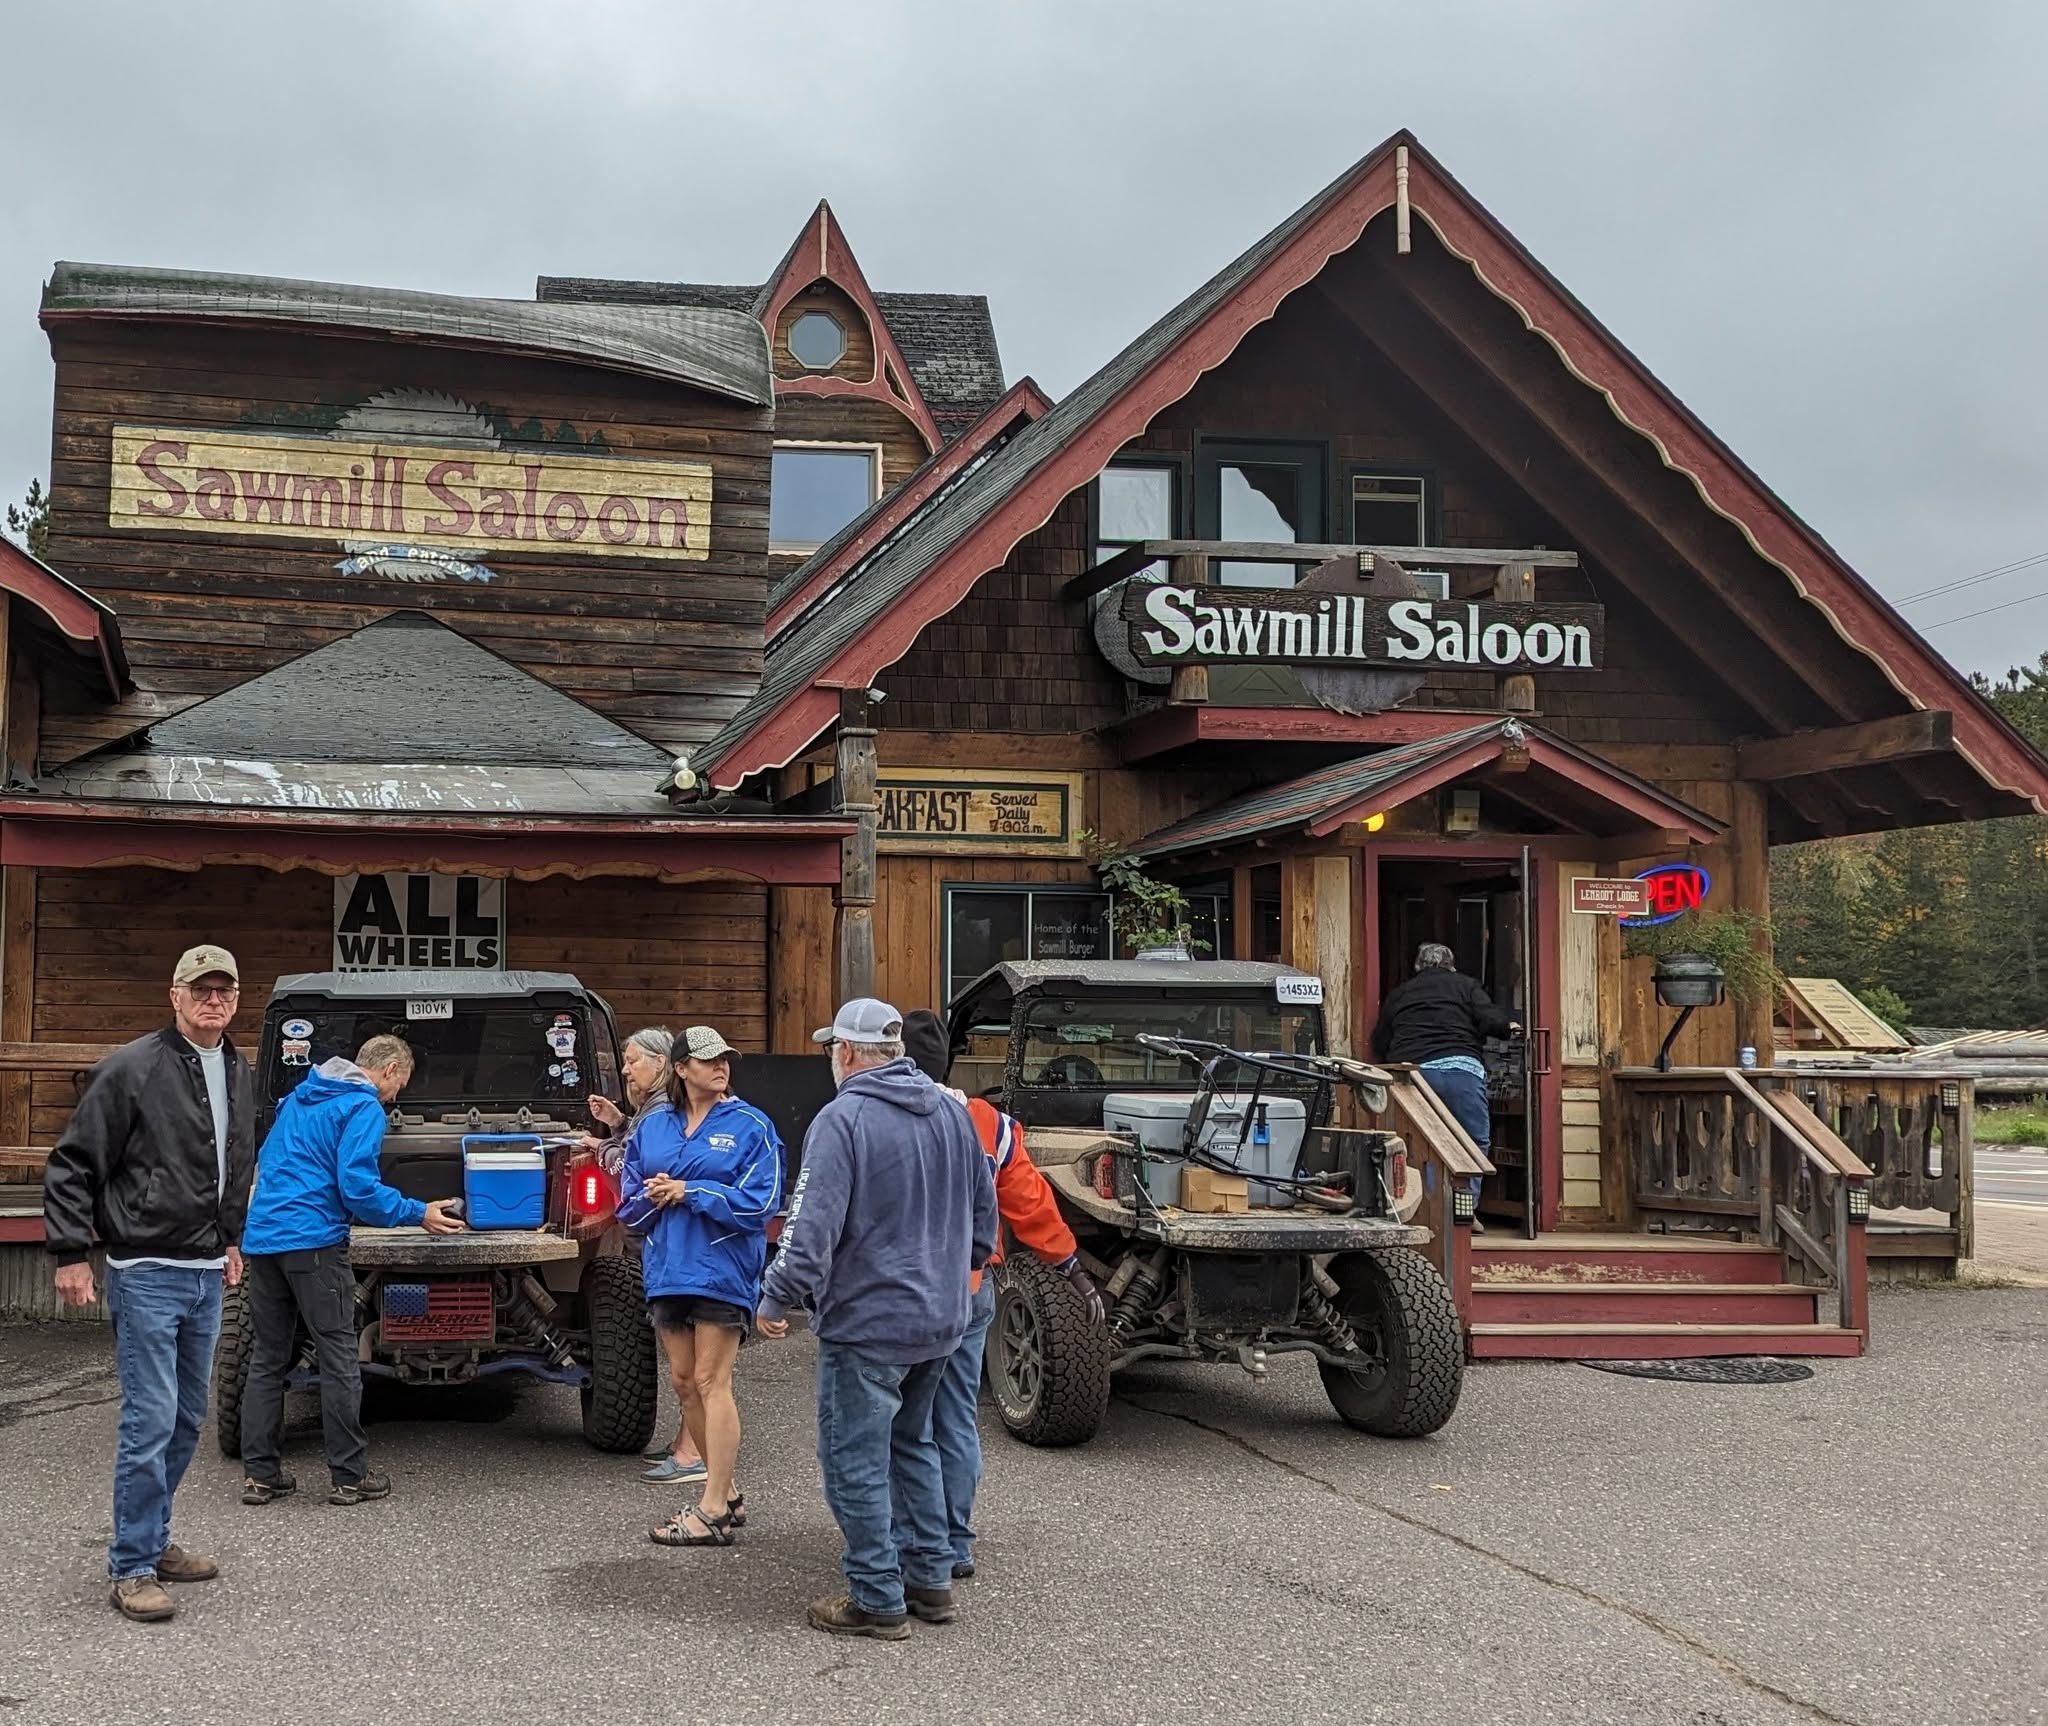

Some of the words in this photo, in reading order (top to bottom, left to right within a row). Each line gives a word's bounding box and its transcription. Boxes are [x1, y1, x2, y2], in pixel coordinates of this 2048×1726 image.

[136, 441, 407, 532] Sawmill
[424, 460, 689, 548] Saloon
[356, 546, 389, 569] and
[1141, 586, 1368, 659] Sawmill
[1385, 600, 1594, 668] Saloon
[990, 792, 1038, 806] Served
[997, 806, 1030, 824] Daily
[1580, 889, 1614, 901] LENROOT
[1616, 890, 1640, 902] LODGE
[1646, 869, 1701, 914] PEN
[338, 874, 498, 937] ALL
[1034, 923, 1063, 934] Home
[1066, 923, 1078, 934] of
[1081, 924, 1099, 935] the
[337, 934, 499, 968] WHEELS
[1039, 939, 1066, 954] Sawmill
[1069, 939, 1095, 958] Burger
[1286, 983, 1320, 996] 1453XZ
[796, 1167, 811, 1192] LOCAL
[788, 1194, 804, 1221] PEOPLE
[783, 1225, 795, 1248] LOCAL
